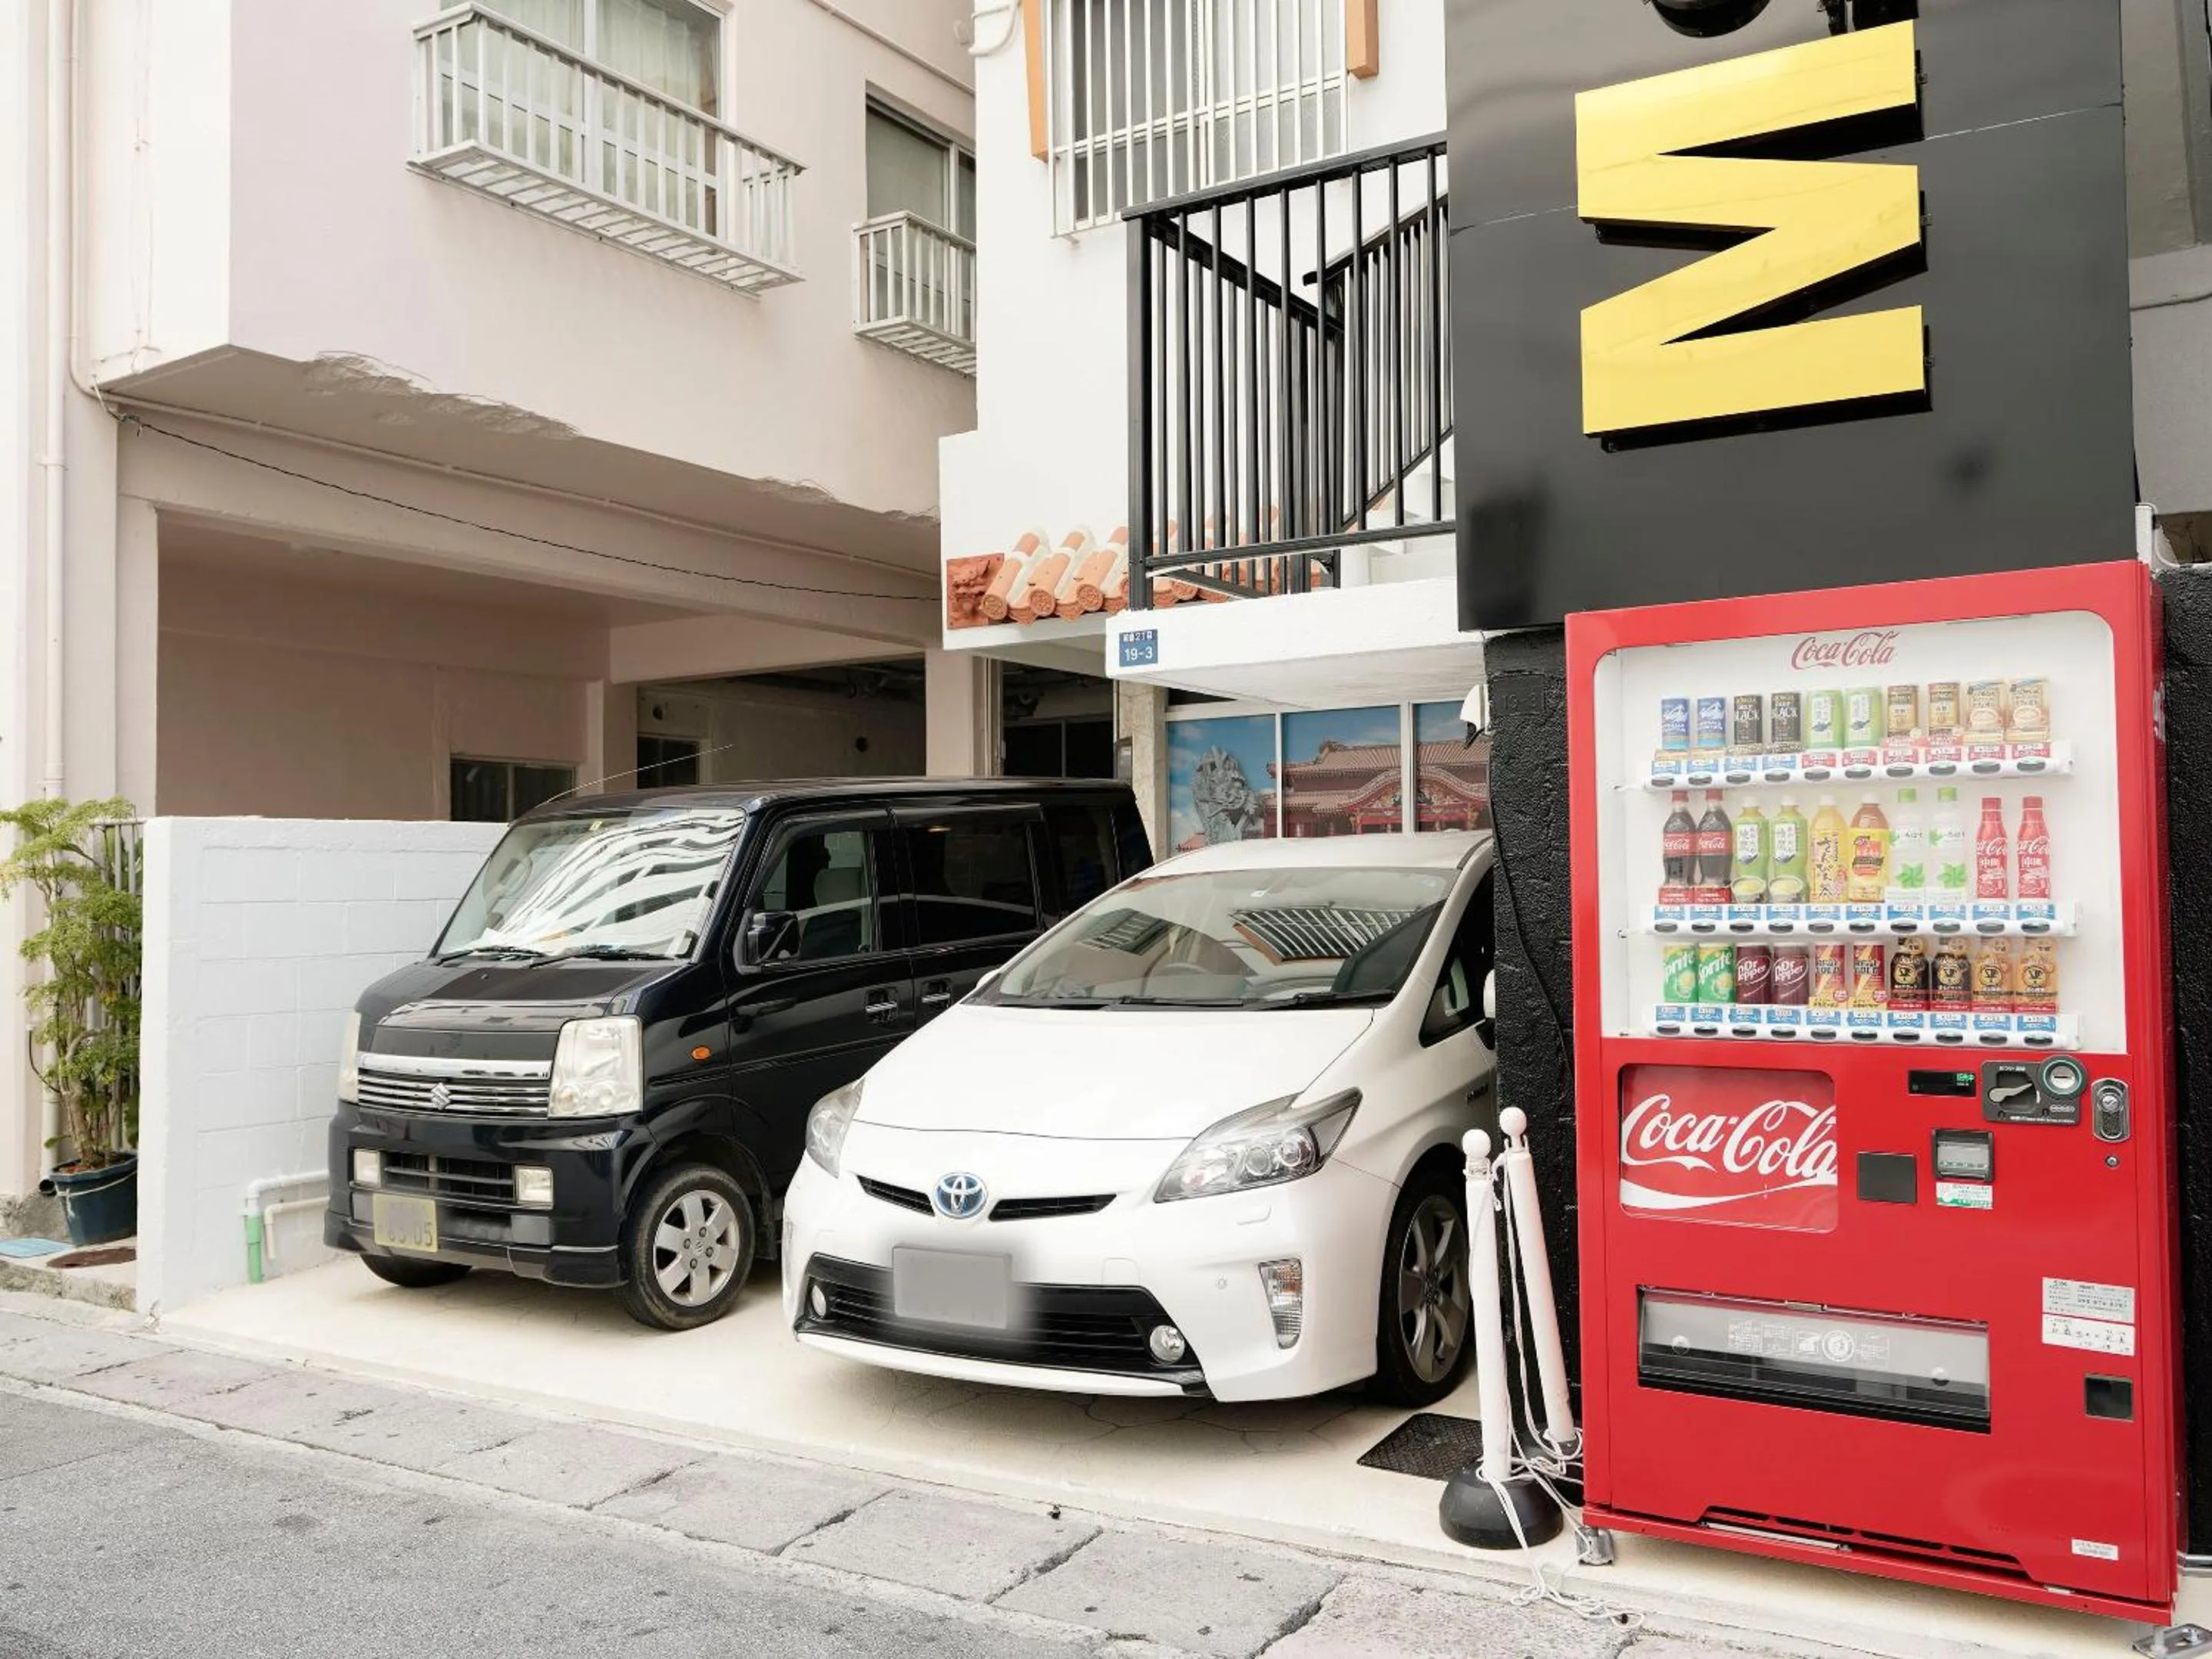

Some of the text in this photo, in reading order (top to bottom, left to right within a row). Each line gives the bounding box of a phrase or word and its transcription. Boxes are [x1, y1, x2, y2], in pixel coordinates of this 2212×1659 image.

[1124, 646, 1153, 661] 19-3
[1791, 631, 1900, 671] Coca-Cola
[1621, 1094, 1837, 1177] Coca-Cola
